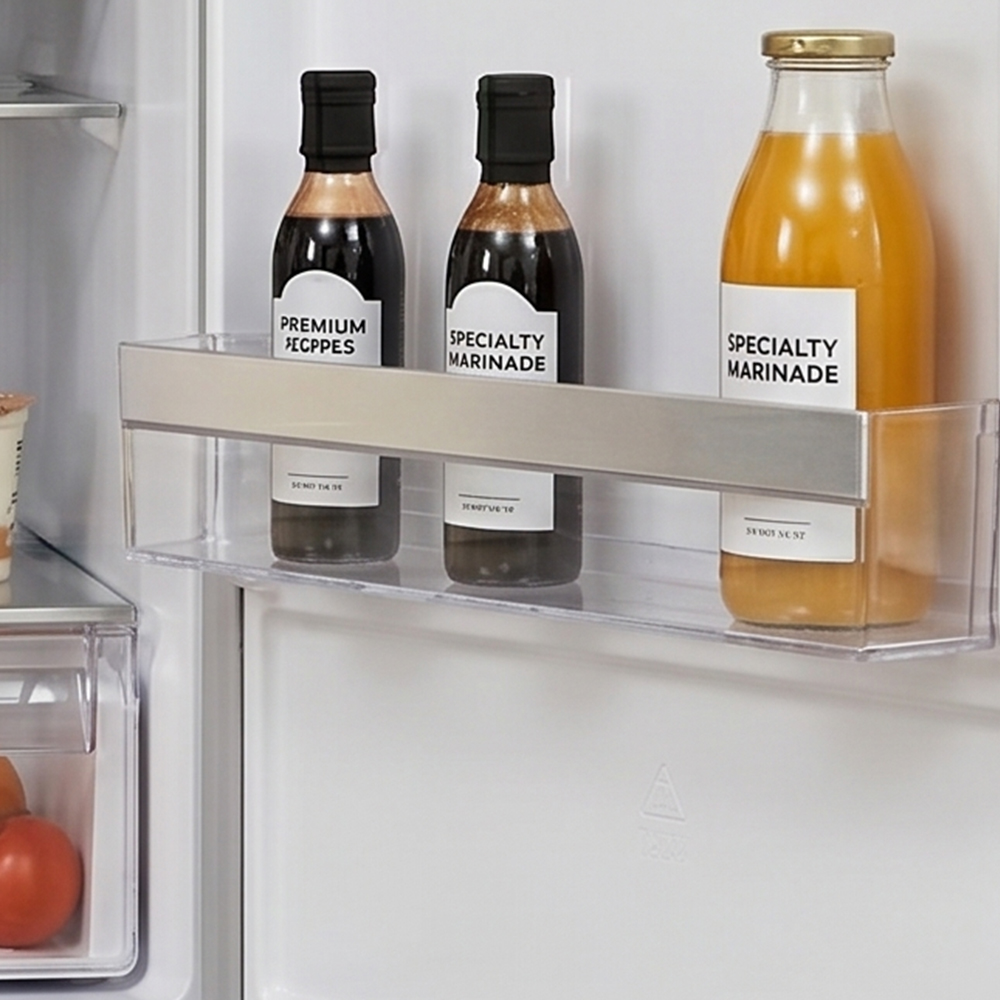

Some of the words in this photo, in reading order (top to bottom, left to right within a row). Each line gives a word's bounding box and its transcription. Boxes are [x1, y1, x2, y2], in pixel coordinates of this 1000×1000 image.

[281, 316, 366, 334] PREMIUM
[449, 330, 545, 350] SPECIALTY
[727, 333, 838, 358] SPECIALTY
[449, 351, 546, 372] MARINADE
[727, 359, 839, 384] MARINADE
